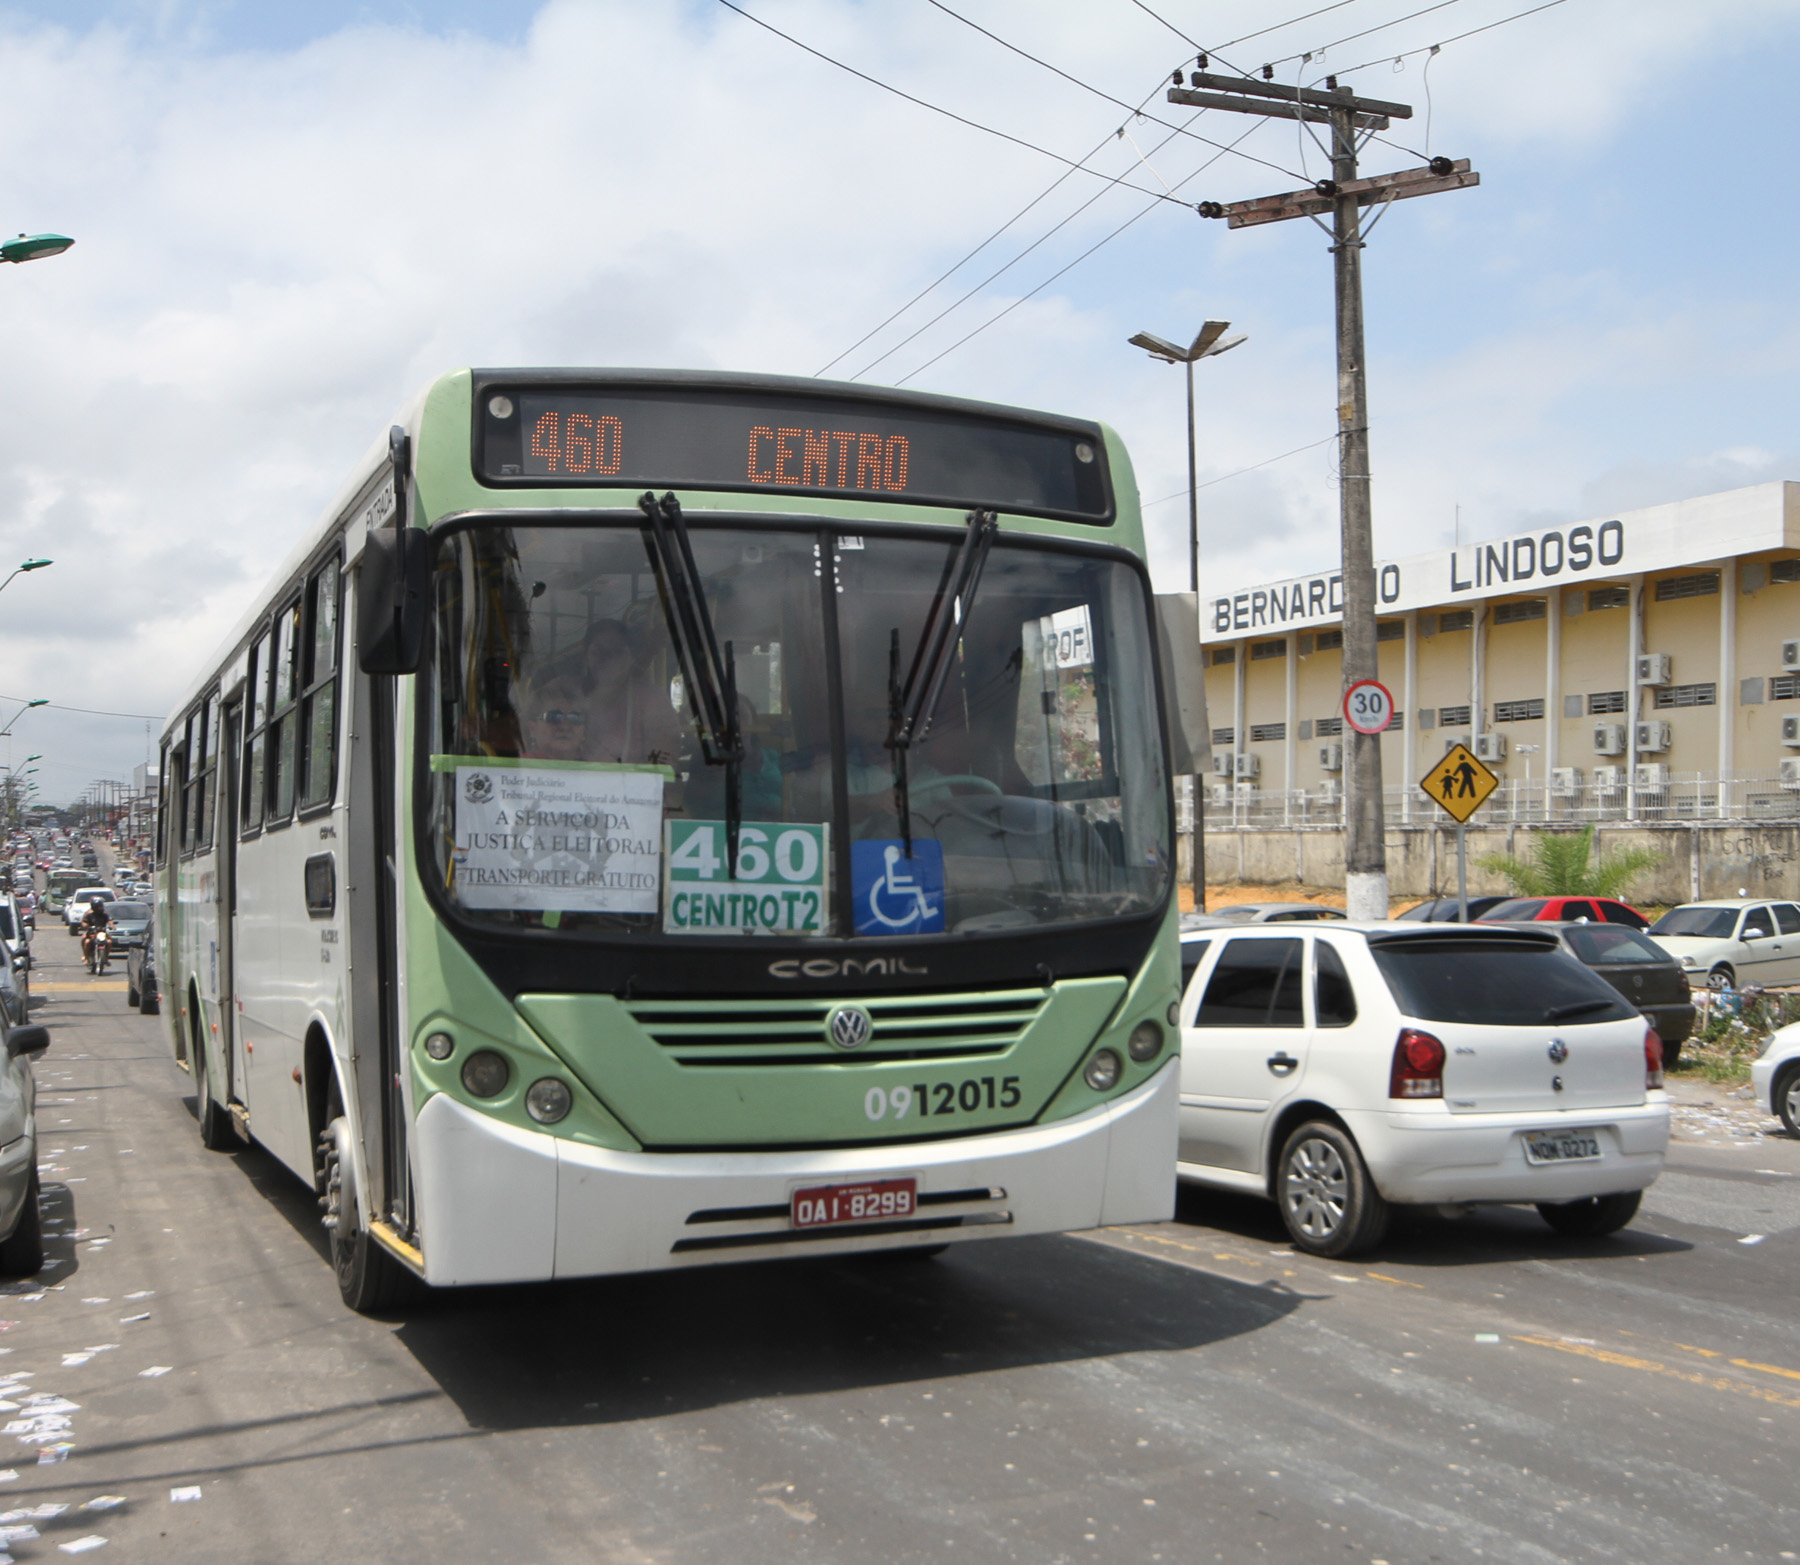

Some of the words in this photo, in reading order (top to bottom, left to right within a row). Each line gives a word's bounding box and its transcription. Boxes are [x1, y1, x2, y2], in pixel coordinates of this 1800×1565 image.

[530, 411, 622, 475] 460
[748, 425, 909, 491] CENTRO
[1216, 564, 1400, 633] BERNARDO
[1451, 520, 1623, 592] LINDOSO
[1354, 692, 1382, 714] 30
[501, 775, 524, 786] Poder
[501, 789, 535, 800] Tribunal
[538, 791, 572, 803] Regional
[574, 792, 608, 804] Eleitoral
[496, 810, 509, 825] A
[515, 810, 598, 831] SERVIÇO
[604, 813, 630, 830] DA
[552, 835, 657, 856] ELEITORAL
[671, 826, 819, 882] 460
[467, 868, 570, 887] TRANSPORTE
[574, 871, 656, 889] GRATUITO
[768, 957, 928, 979] COMIL
